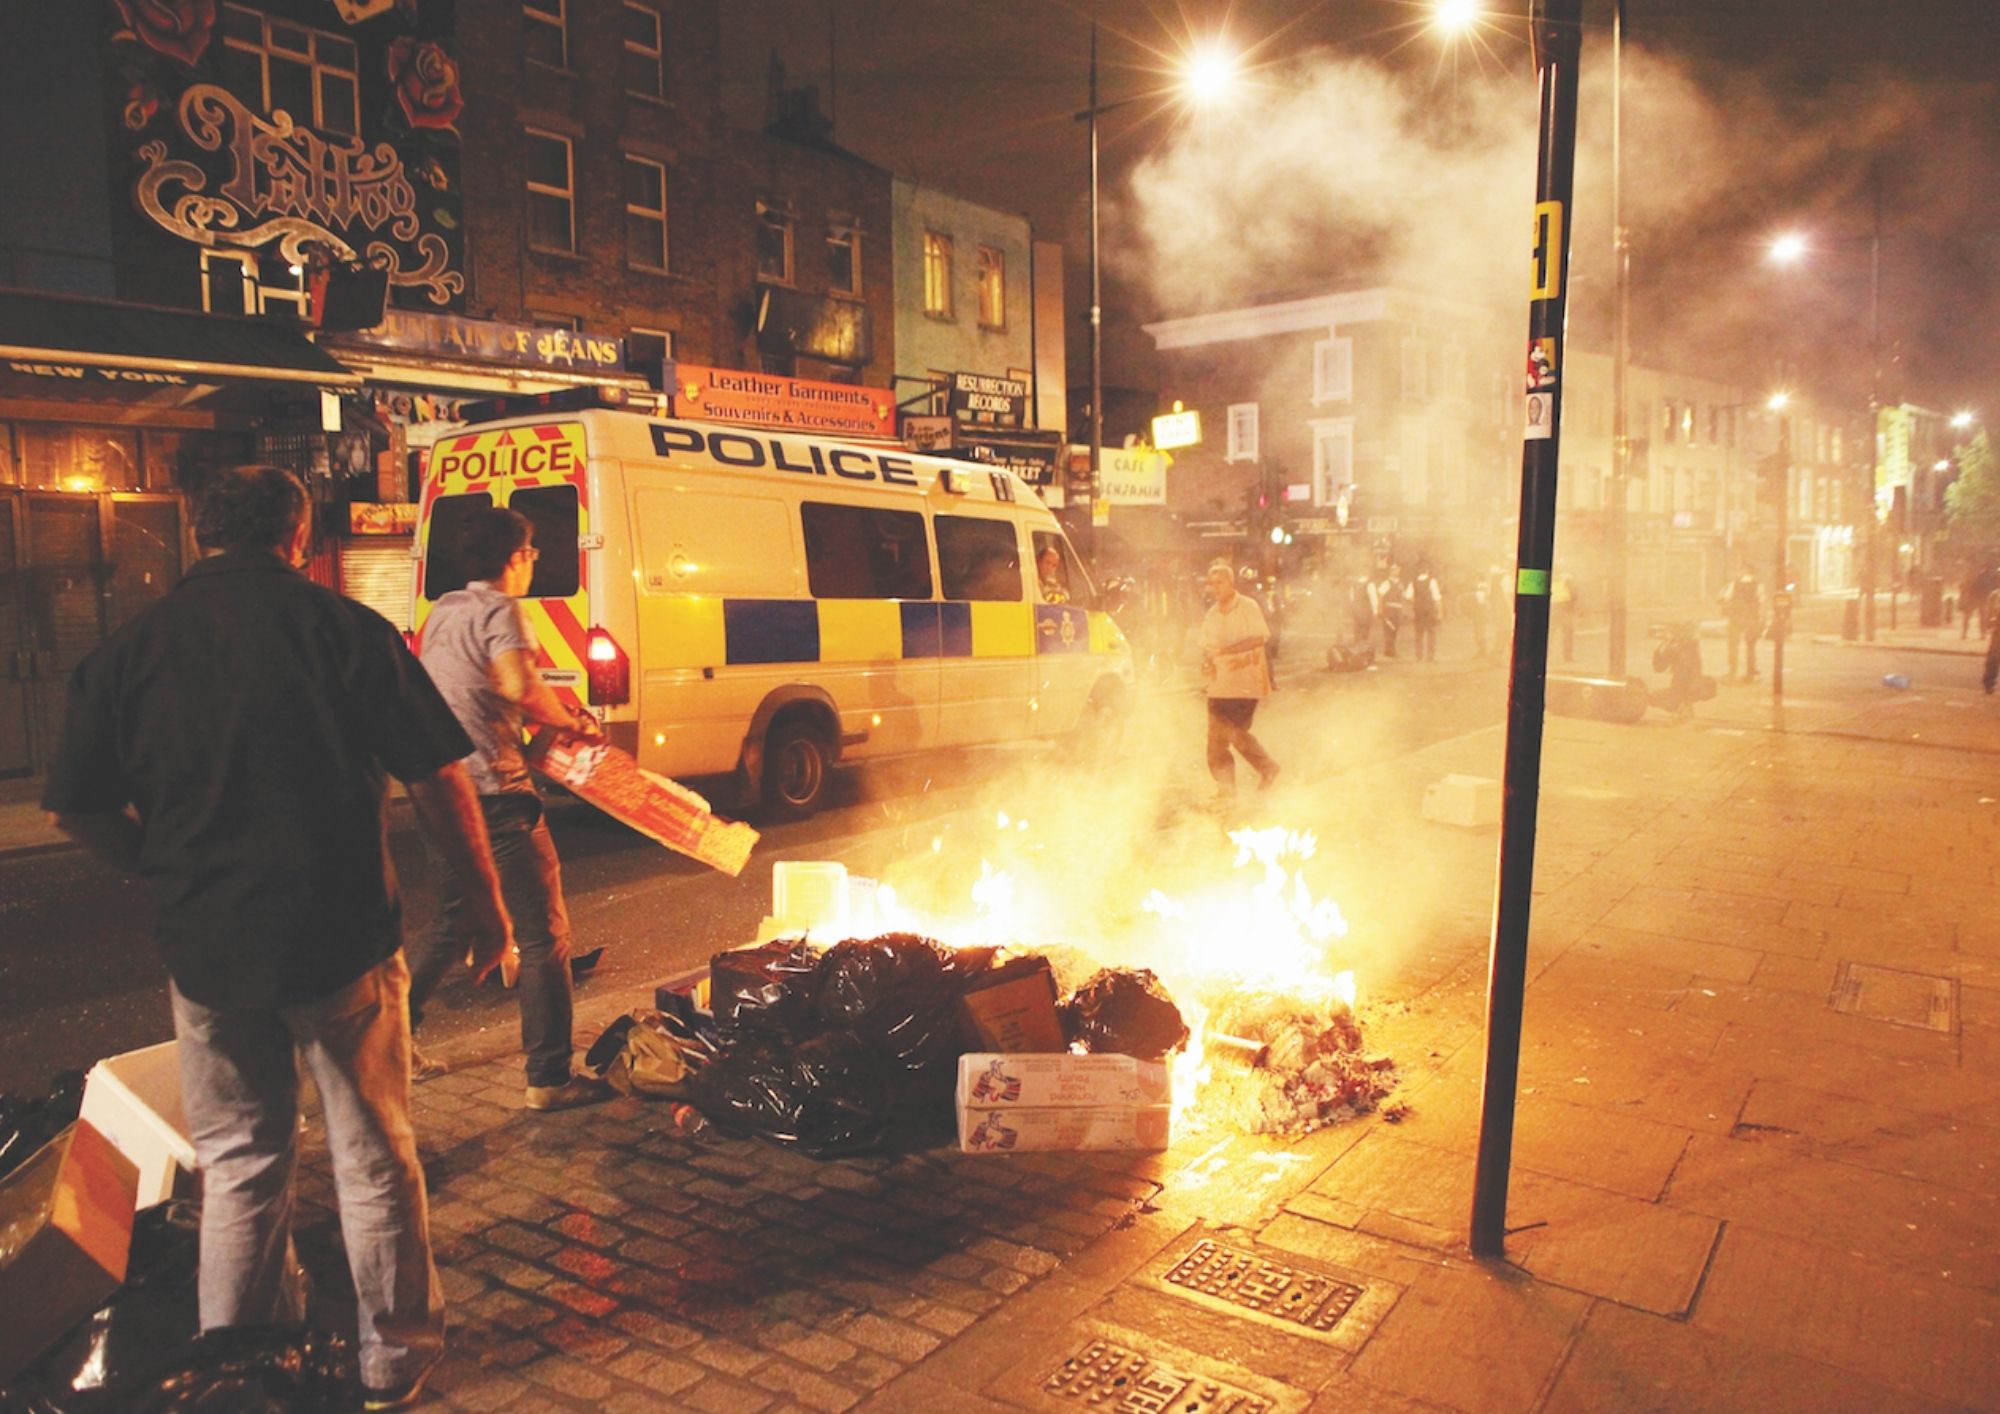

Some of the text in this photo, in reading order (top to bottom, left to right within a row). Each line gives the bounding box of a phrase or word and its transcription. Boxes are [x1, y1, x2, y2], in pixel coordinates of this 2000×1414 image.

[180, 84, 419, 240] Tattoo
[536, 329, 618, 364] JEANS
[9, 361, 188, 385] NEW YORK
[708, 371, 783, 398] Leather
[789, 381, 871, 406] Garments
[956, 374, 1024, 396] RESURRECTION
[703, 402, 781, 422] Souvenirs
[783, 411, 794, 424] &
[797, 412, 877, 431] Accessories
[968, 393, 1011, 412] RECORDS
[440, 442, 573, 483] POLICE
[649, 423, 918, 486] POLICE
